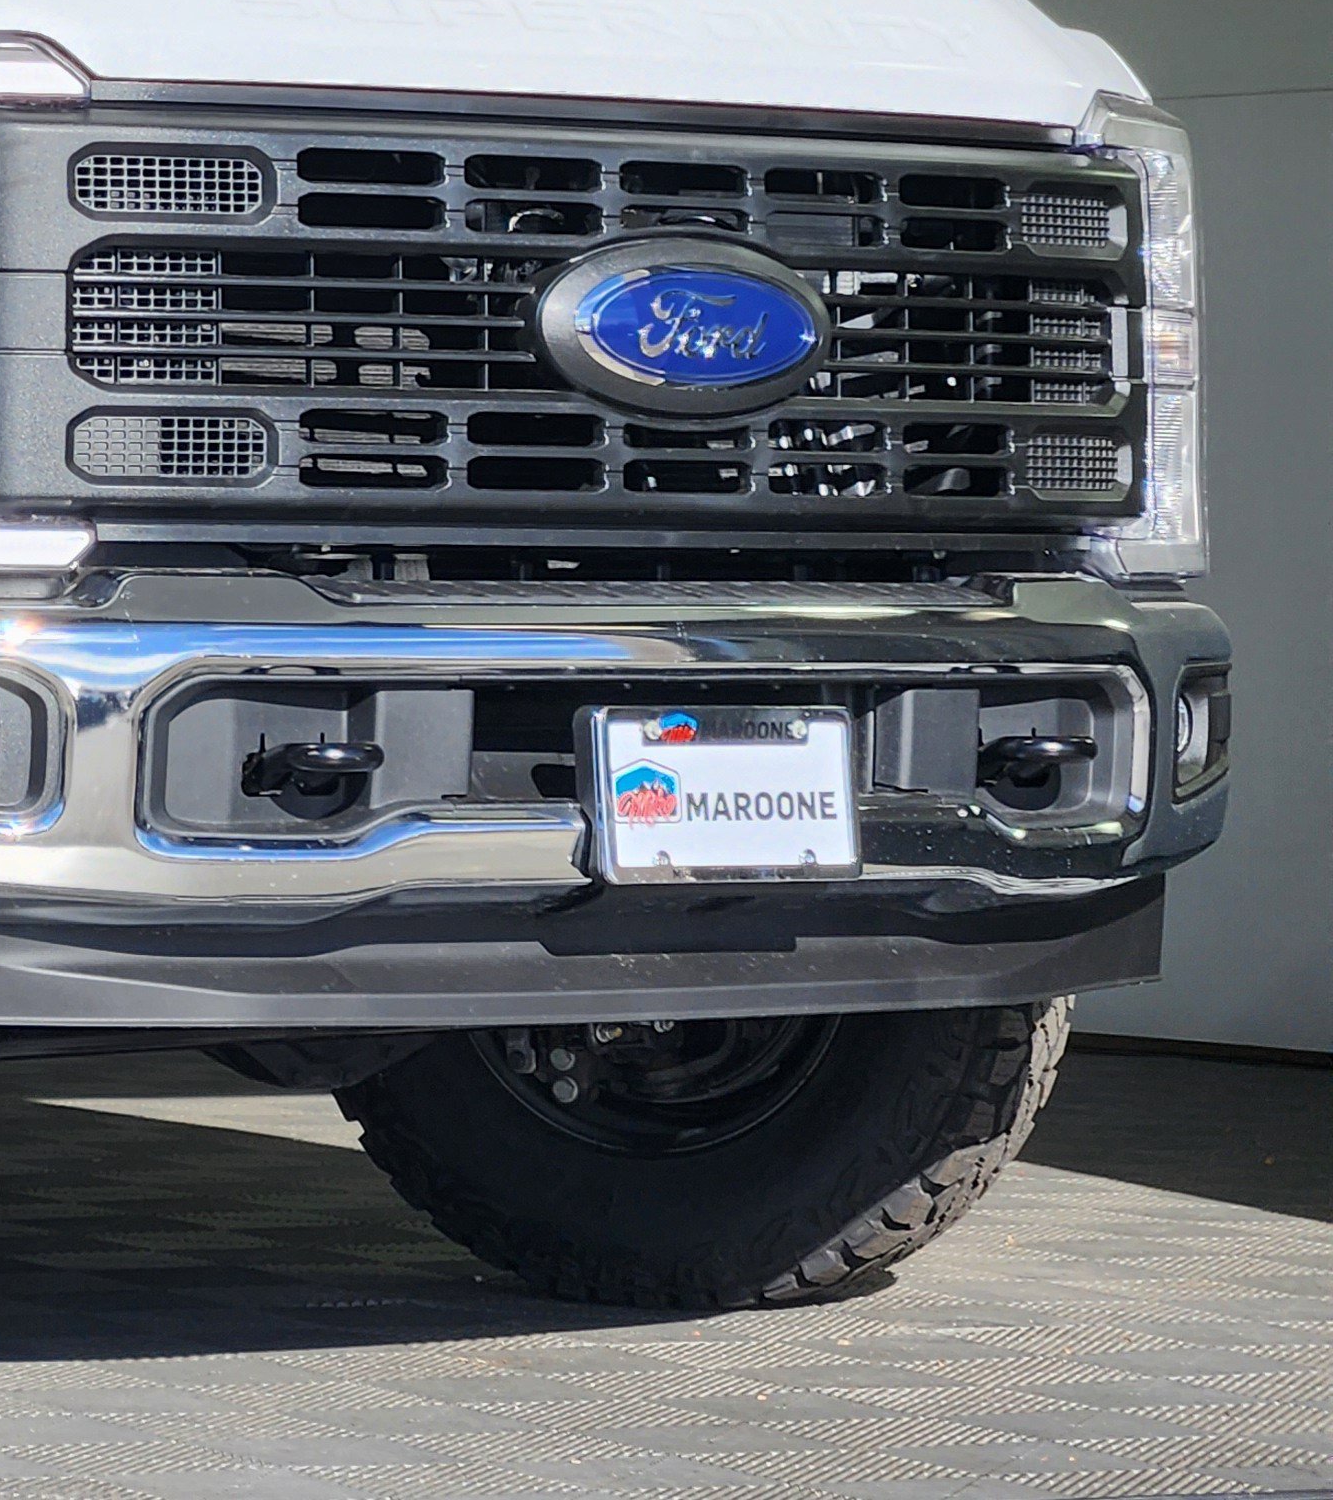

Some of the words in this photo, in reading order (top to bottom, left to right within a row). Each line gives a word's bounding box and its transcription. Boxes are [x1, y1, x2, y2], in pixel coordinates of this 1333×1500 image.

[701, 8, 977, 58] DUTY
[637, 288, 769, 362] Ford
[686, 791, 838, 822] MAROONE
